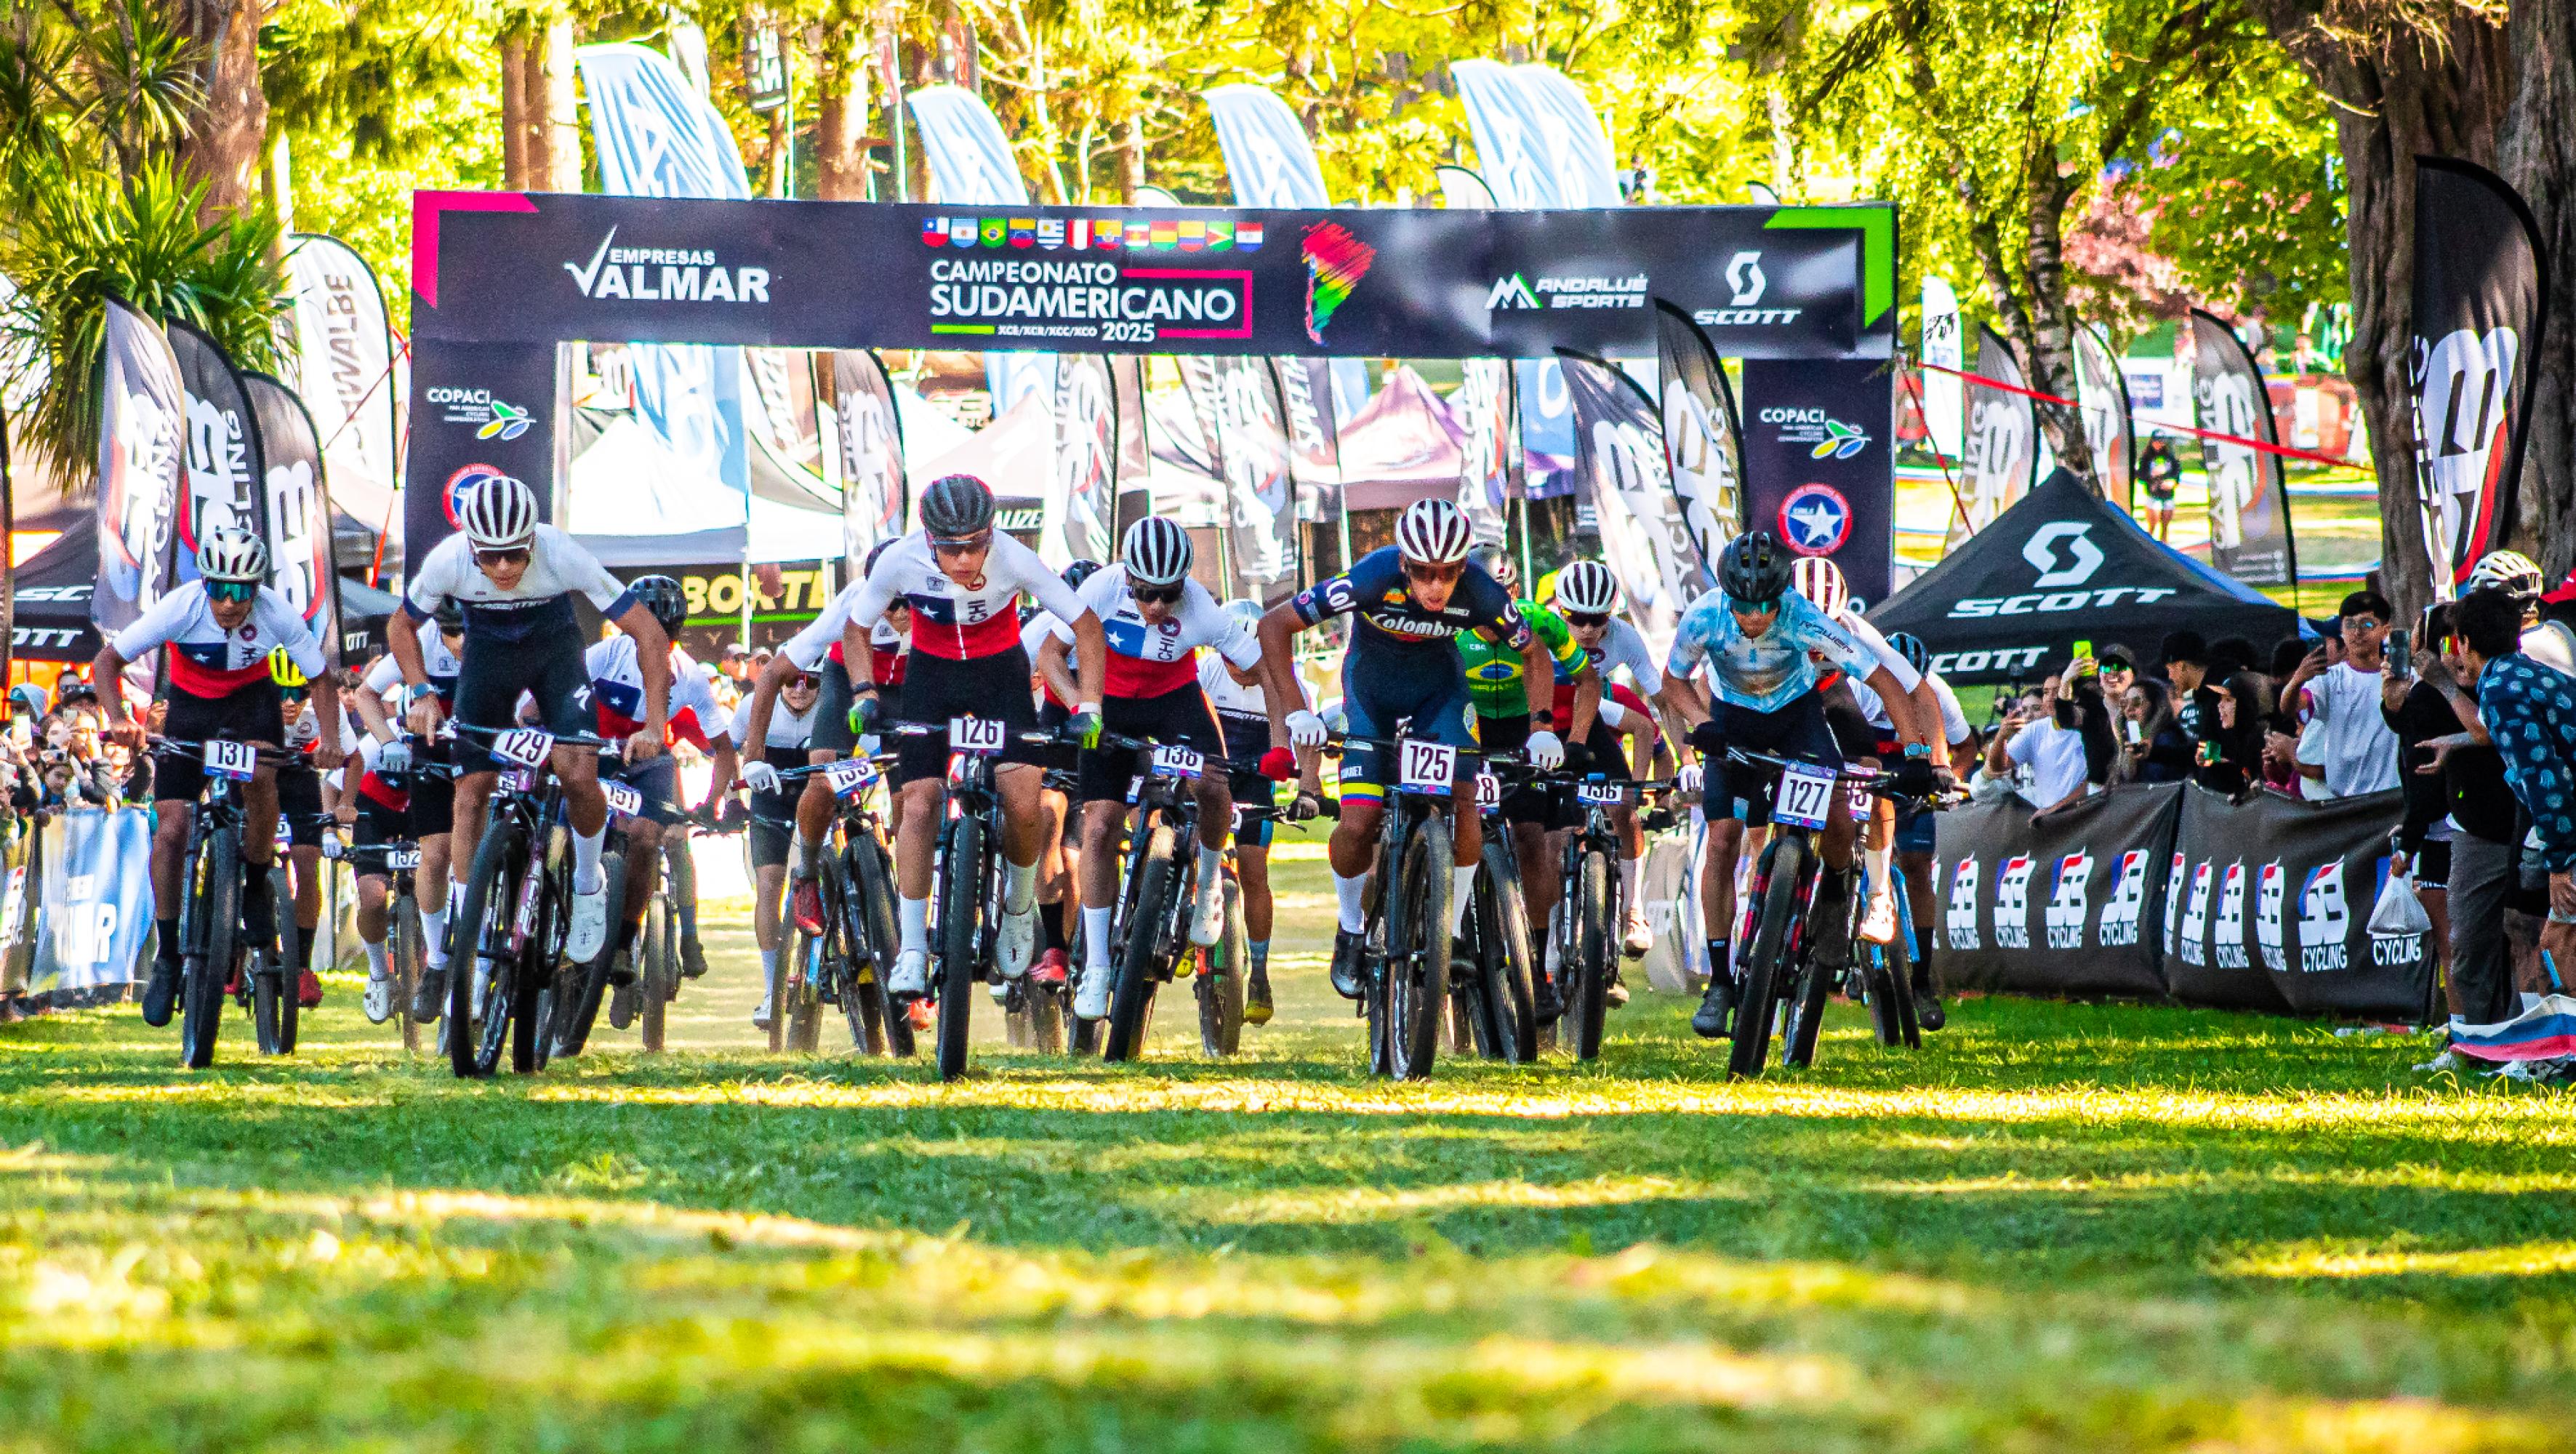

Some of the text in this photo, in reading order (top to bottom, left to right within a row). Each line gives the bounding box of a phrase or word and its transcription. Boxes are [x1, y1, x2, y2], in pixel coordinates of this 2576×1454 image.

[609, 249, 715, 265] EMPRESAS
[930, 261, 1118, 284] CAMPEONATO
[930, 286, 1236, 321] SUDAMERICANO
[1550, 294, 1645, 308] SPORTS
[1694, 309, 1802, 326] SCOTT
[1102, 321, 1155, 342] 2025
[427, 388, 490, 403] COPACI
[1760, 408, 1825, 423] COPACI
[1947, 587, 2177, 619] SCOTT
[1157, 637, 1175, 662] CHI
[1928, 646, 2050, 675] COTT
[962, 718, 998, 745] 126
[217, 741, 247, 768] 131
[505, 731, 547, 763] 129
[1410, 744, 1450, 782] 125
[1786, 779, 1828, 816] 127
[2047, 925, 2082, 949] CYCLING
[2099, 920, 2138, 946] CYCLING
[2301, 944, 2348, 973] CYCLING
[2372, 936, 2423, 965] CYCLING
